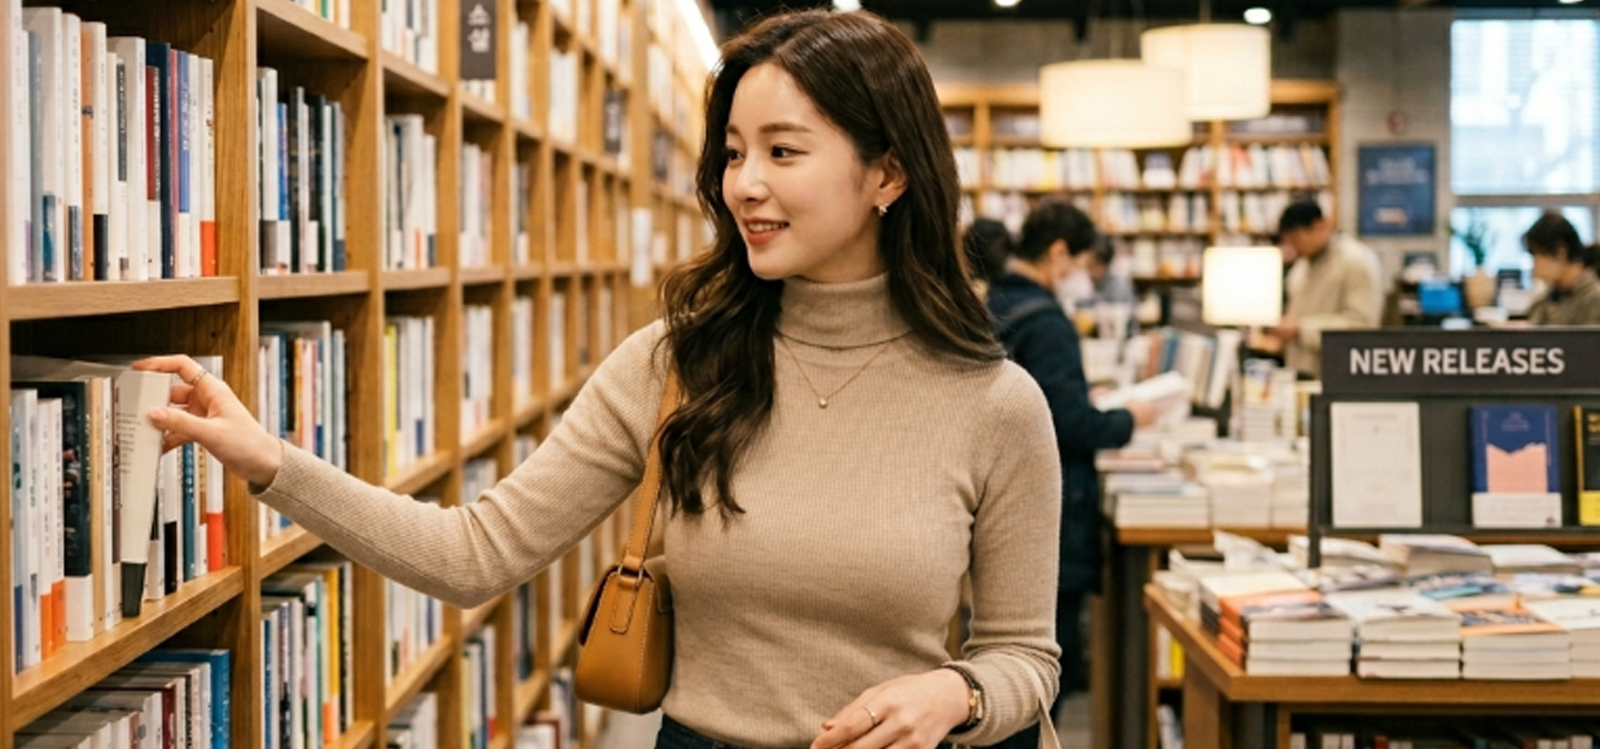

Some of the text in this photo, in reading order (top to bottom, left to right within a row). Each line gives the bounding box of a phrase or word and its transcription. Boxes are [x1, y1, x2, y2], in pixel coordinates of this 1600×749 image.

[467, 3, 491, 53] 소설
[1350, 348, 1565, 375] NEW RELEASES
